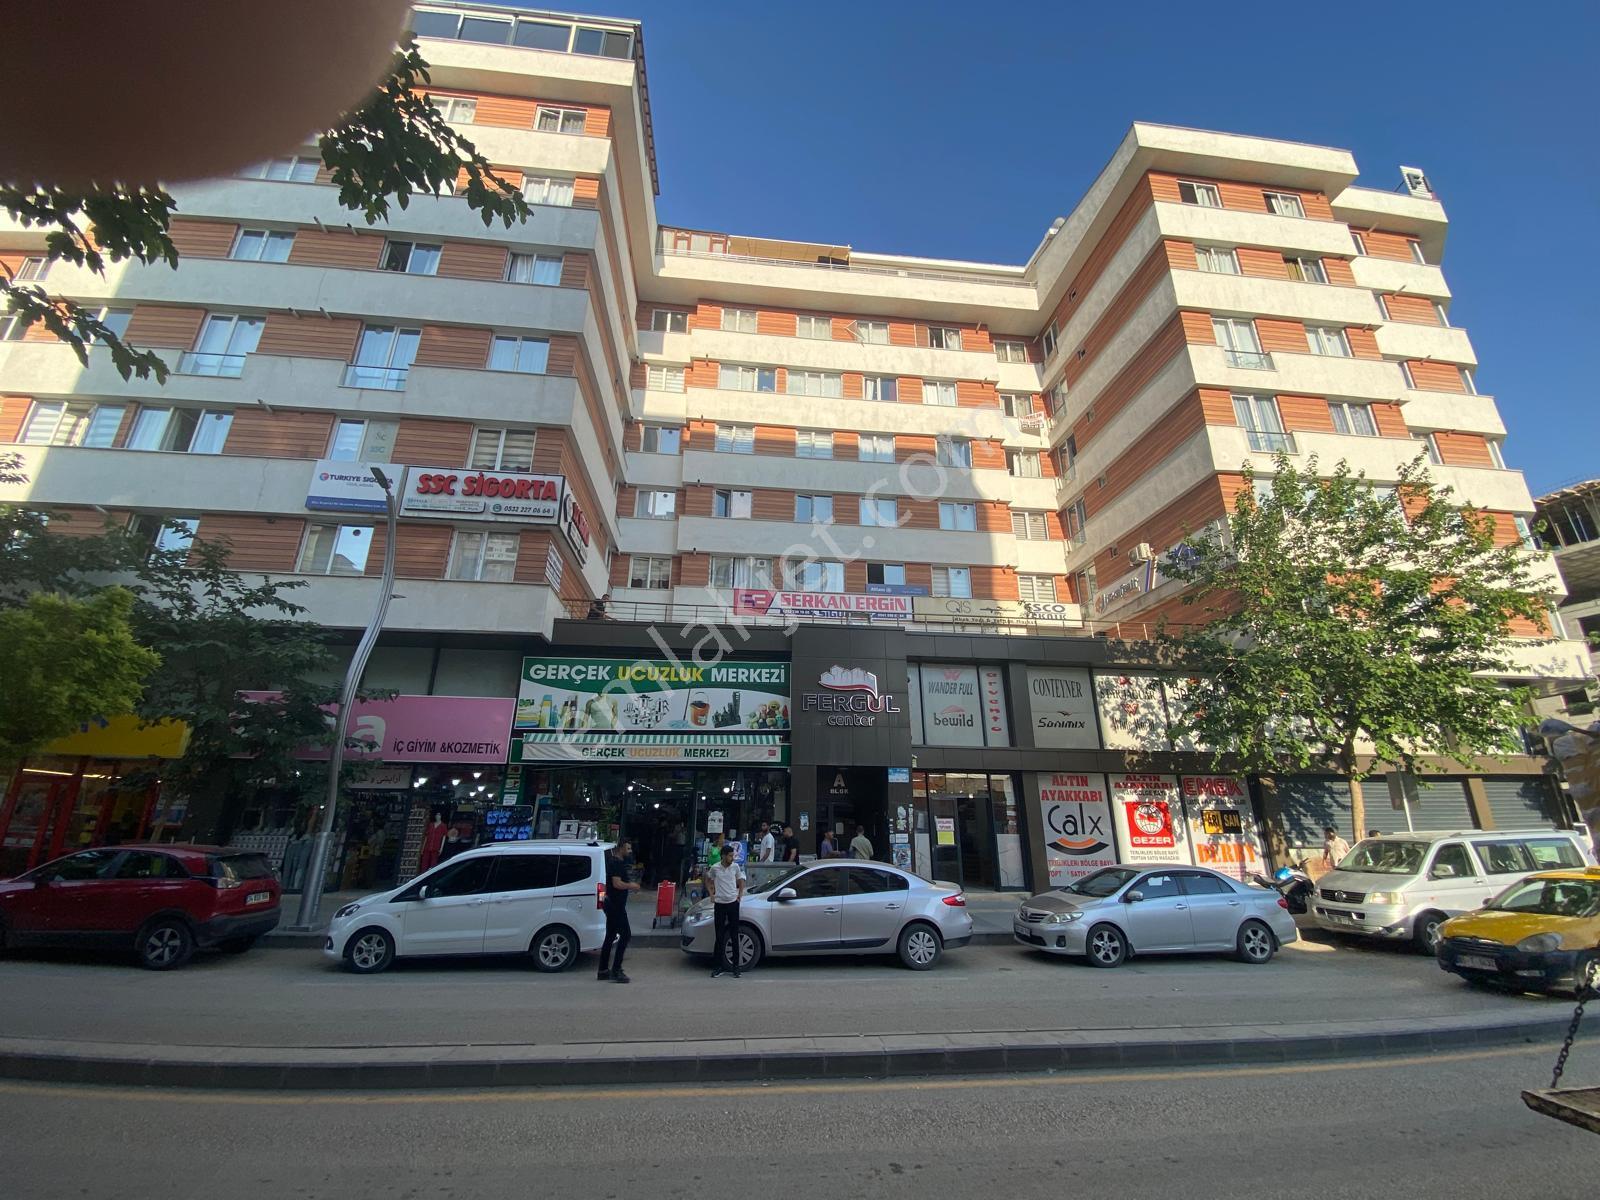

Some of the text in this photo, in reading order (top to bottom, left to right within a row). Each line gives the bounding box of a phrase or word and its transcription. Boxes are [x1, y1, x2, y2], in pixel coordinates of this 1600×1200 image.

[416, 471, 558, 501] SSC SİGORTA
[780, 593, 850, 610] SERKAN
[529, 664, 785, 685] GERÇEK UCUZLUK MERKEZİ
[928, 681, 974, 695] WANDER FULL
[827, 713, 876, 726] center
[933, 712, 974, 727] bewild
[406, 738, 437, 753] GİYİM
[440, 740, 501, 755] &KOZMETİK
[581, 747, 625, 759] GERÇEK
[629, 747, 680, 758] UCUZLUK
[833, 773, 846, 787] A
[1052, 775, 1089, 787] ALTIN
[1182, 777, 1244, 796] EMEK
[1041, 789, 1103, 802] AYAKKABI
[1047, 802, 1104, 836] Calx
[1223, 813, 1240, 827] SAN
[1132, 836, 1171, 845] GEZER
[1197, 843, 1256, 863] DERBY
